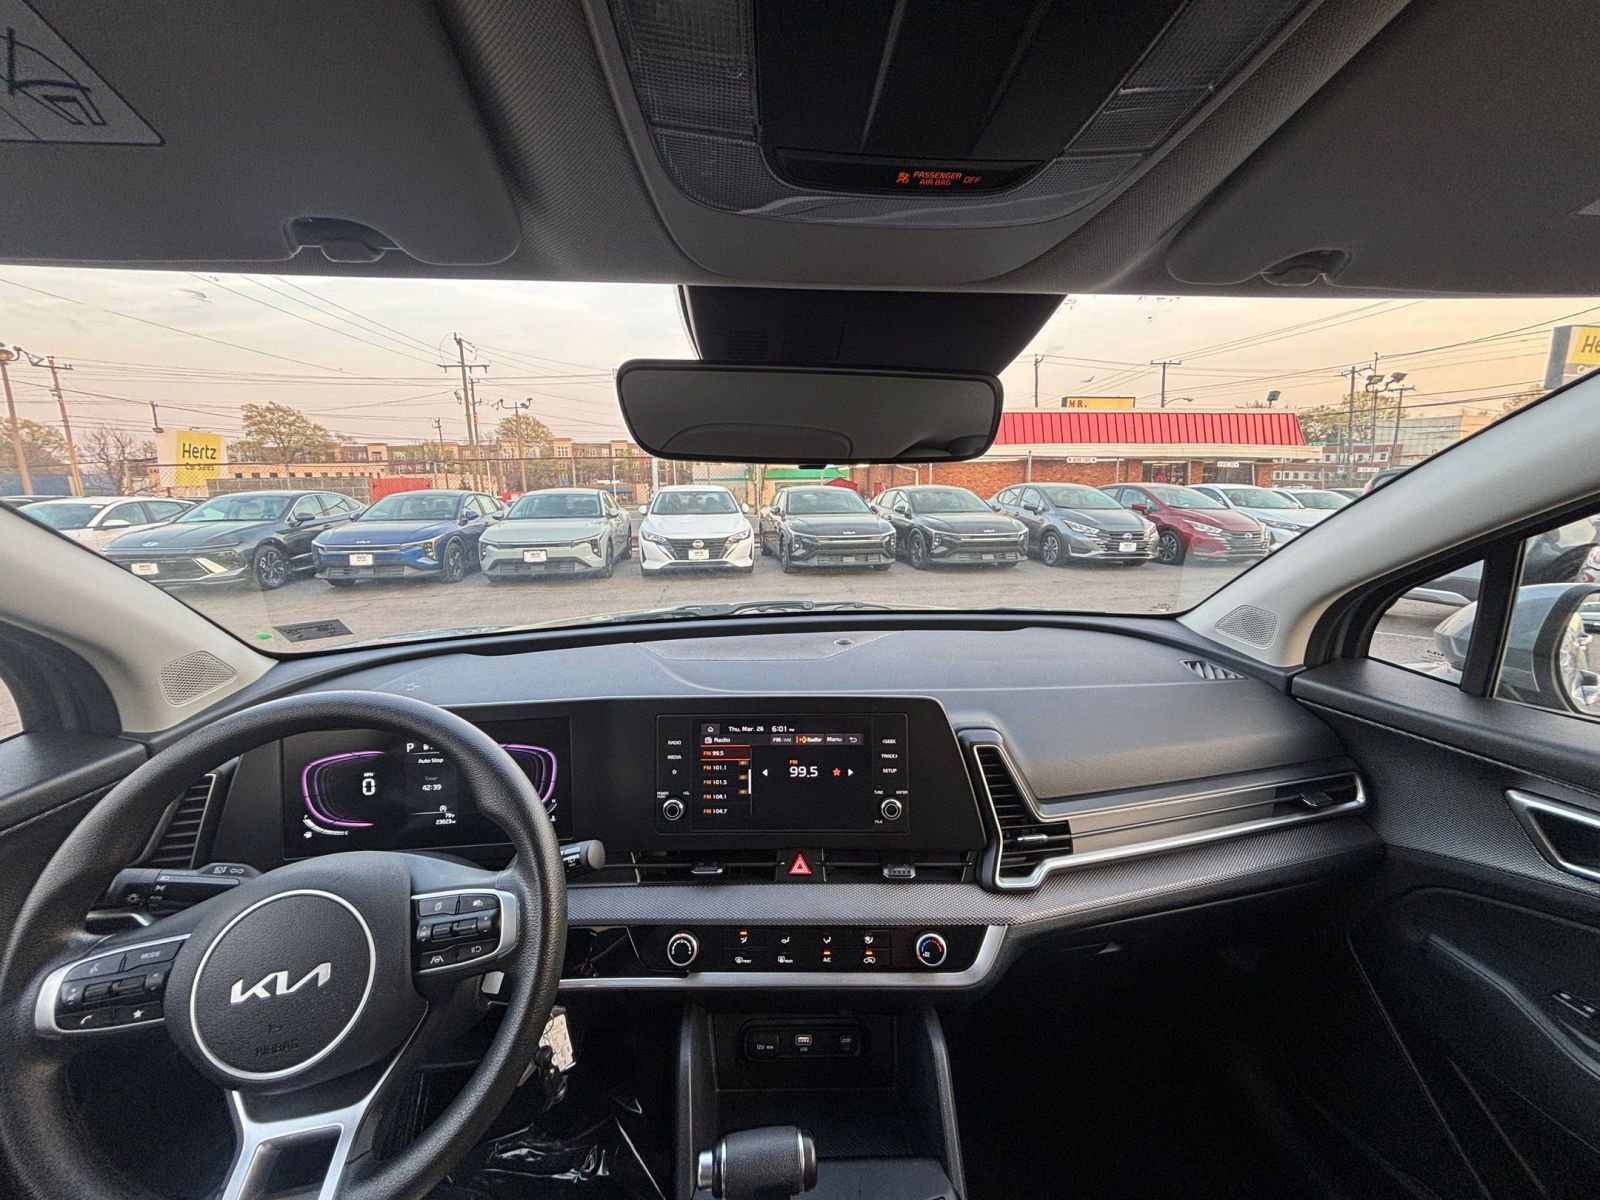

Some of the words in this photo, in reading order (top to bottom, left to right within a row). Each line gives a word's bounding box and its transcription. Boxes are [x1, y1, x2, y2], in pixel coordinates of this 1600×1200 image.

[913, 171, 962, 180] PASSENGER
[964, 176, 981, 184] OFF
[1068, 399, 1088, 408] MR.
[182, 442, 217, 460] Hertz
[406, 742, 415, 752] P
[789, 766, 819, 778] 99.5
[362, 778, 376, 796] 0
[422, 783, 442, 791] 42:39
[140, 950, 161, 960] MODE
[255, 1040, 300, 1057] AIRBAG
